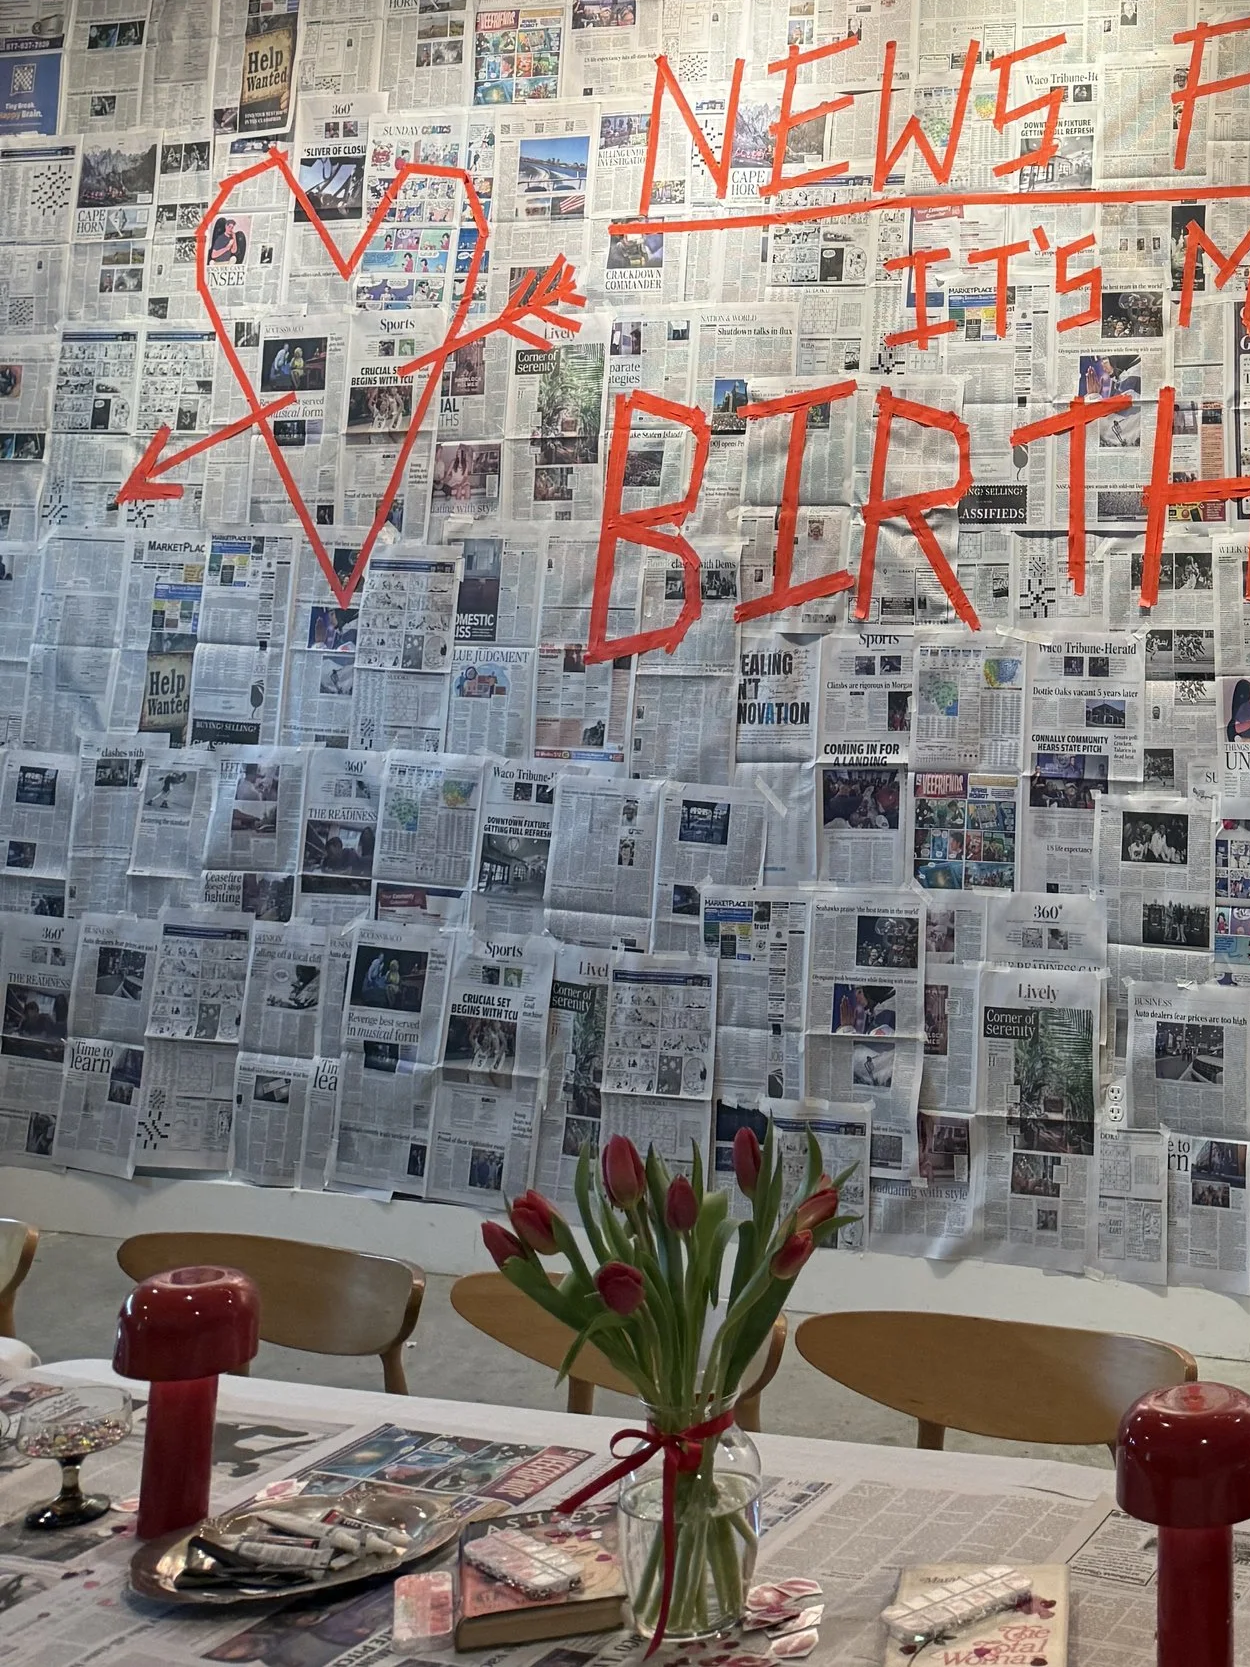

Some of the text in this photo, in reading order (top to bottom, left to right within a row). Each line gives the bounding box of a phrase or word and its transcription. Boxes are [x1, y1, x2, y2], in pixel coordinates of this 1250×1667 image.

[247, 48, 284, 75] Help
[246, 69, 288, 92] Wanted
[383, 124, 451, 136] SUNDAY COMICS
[638, 32, 1067, 216] NEWS
[78, 208, 106, 222] CAPE
[77, 221, 105, 234] HORN
[606, 269, 662, 280] CRACKDOWN
[605, 279, 662, 290] COMMANDER
[883, 225, 1102, 351] IT'S
[380, 318, 415, 331] Sports
[518, 351, 558, 363] Corner of
[517, 360, 559, 373] serenity
[149, 669, 186, 697] Help
[1032, 687, 1052, 697] Dottie
[1054, 687, 1072, 697] Oaks
[1074, 688, 1095, 697] vacant
[1104, 689, 1121, 699] years
[148, 693, 189, 716] Wanted
[1032, 734, 1108, 745] CONNALLY COMMUNITY
[1038, 743, 1102, 754] HEARS STATE PITCH
[1224, 743, 1247, 752] THINGS
[308, 808, 377, 822] THE READINESS
[205, 872, 242, 885] Ceasefire
[204, 891, 241, 906] fighting
[484, 941, 523, 959] Sports
[1018, 982, 1059, 1003] Lively
[463, 993, 511, 1007] CRUCIAL SET
[1134, 997, 1173, 1007] BUSINESS
[452, 1003, 518, 1021] BEGINS WITH TCU
[985, 1008, 1036, 1024] Corner of
[1134, 1009, 1248, 1027] Auto dealers fear prices are too high
[348, 1012, 420, 1030] Revenge best served
[346, 1024, 419, 1043] in musical form
[985, 1022, 1036, 1039] serenity
[75, 1041, 114, 1057] Time to
[70, 1053, 111, 1073] learn
[487, 1510, 610, 1535] ASHEY
[998, 1625, 1050, 1639] The
[973, 1639, 1048, 1653] Total
